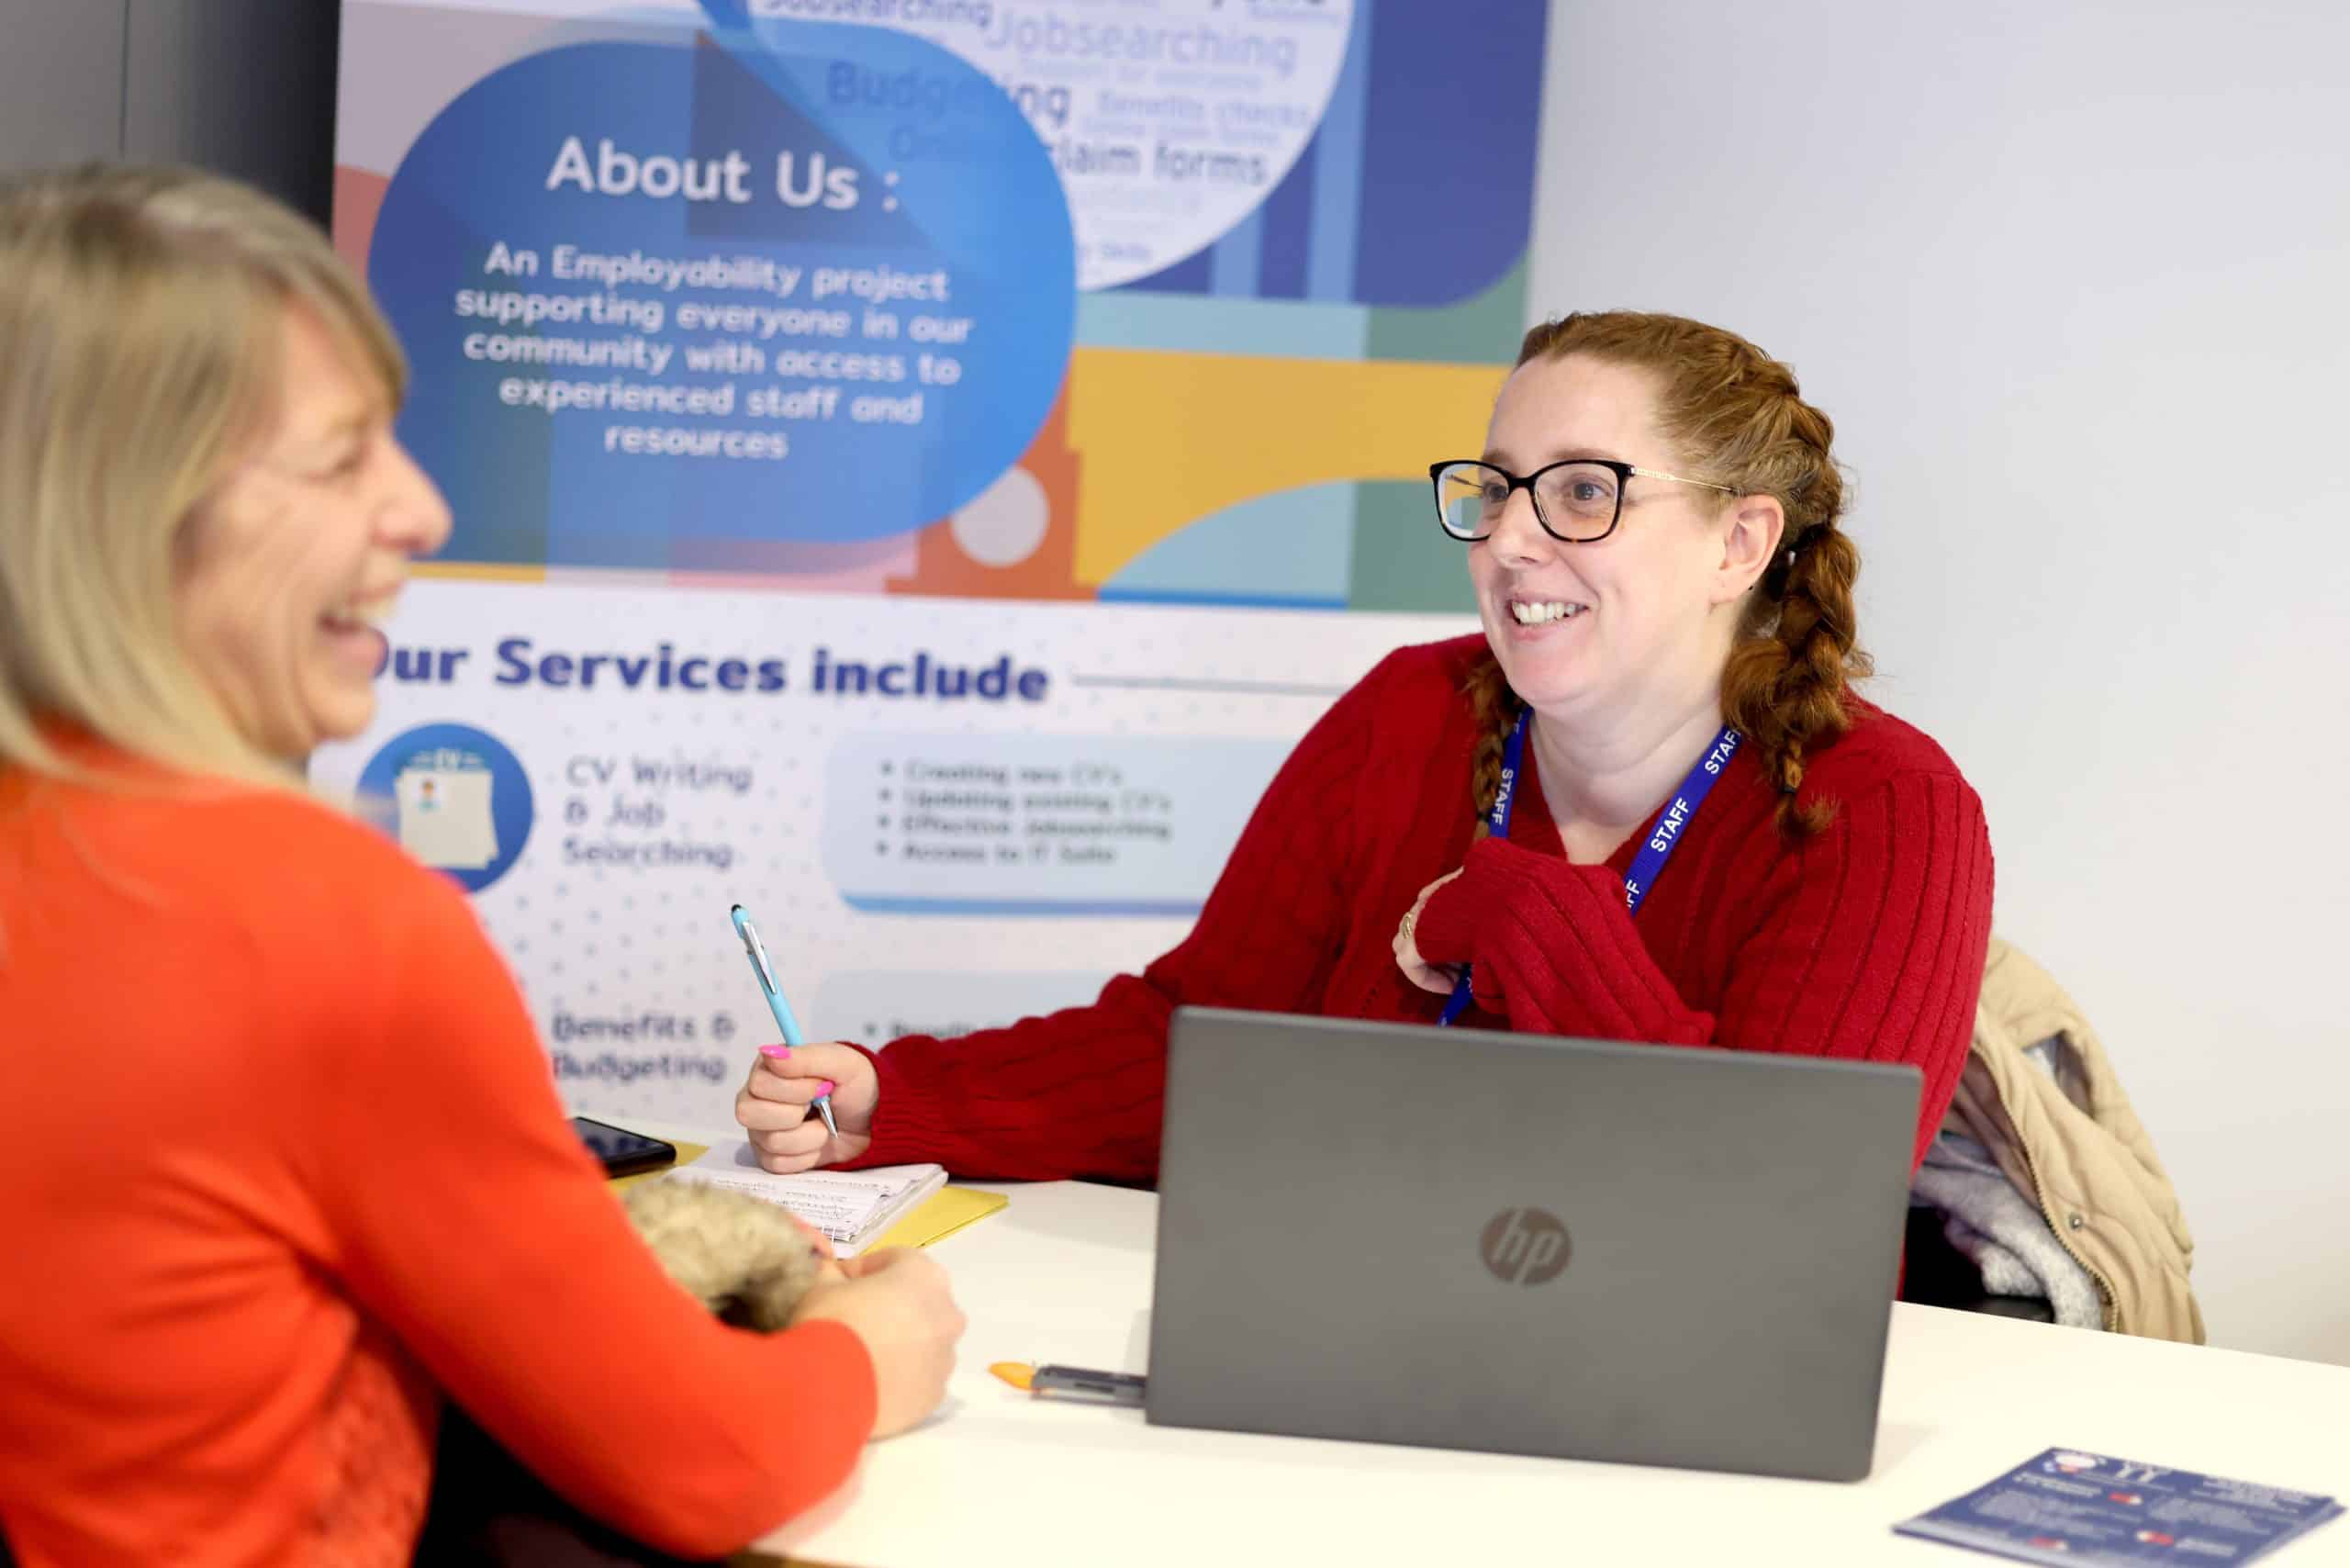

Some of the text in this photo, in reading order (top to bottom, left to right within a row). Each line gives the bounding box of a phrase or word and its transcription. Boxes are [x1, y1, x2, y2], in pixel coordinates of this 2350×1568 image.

[985, 9, 1298, 80] Jobsearching
[546, 136, 899, 211] About Us :
[1153, 140, 1270, 185] forms
[485, 241, 949, 302] An Employability project
[455, 286, 973, 343] supporting everyone in our
[464, 330, 961, 385] community with access to
[498, 375, 923, 423] experienced staff and
[604, 424, 789, 459] resources
[494, 637, 787, 693] Services
[812, 645, 1050, 702] include
[565, 756, 754, 797] CV Writing
[1491, 767, 1514, 825] STAFF
[609, 801, 666, 830] Job
[1651, 797, 1690, 852] STAFF
[563, 838, 733, 872] Searching
[554, 1012, 695, 1041] Benefits
[1490, 1207, 1563, 1285] hp
